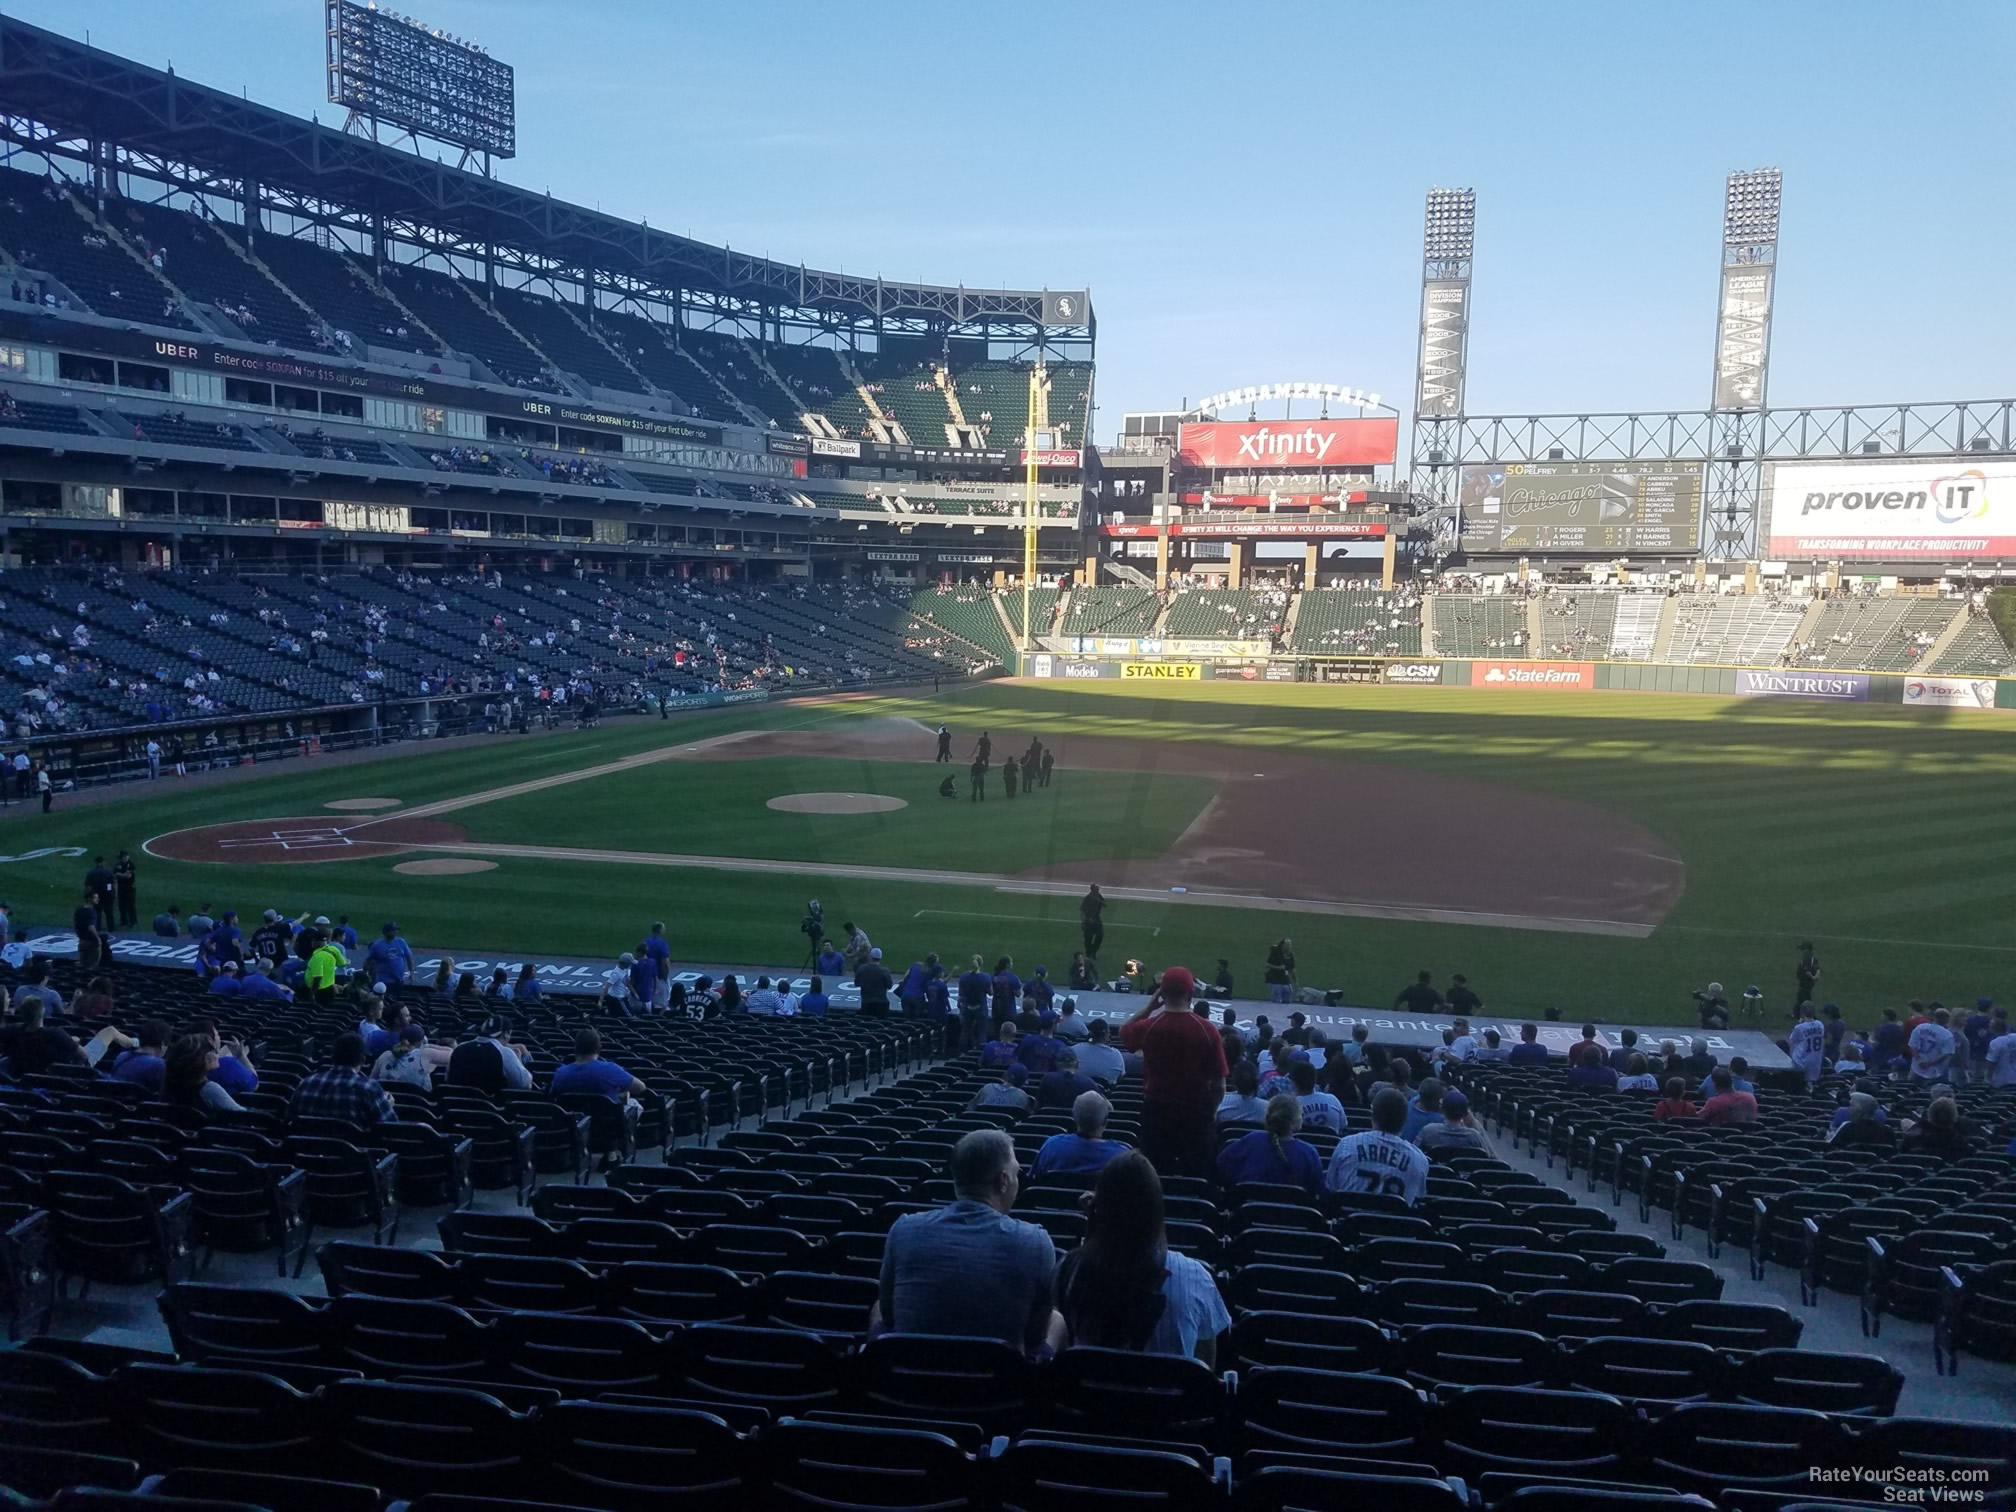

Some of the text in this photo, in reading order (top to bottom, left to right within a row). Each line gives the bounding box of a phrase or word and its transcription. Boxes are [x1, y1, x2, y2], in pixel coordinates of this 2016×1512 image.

[155, 342, 198, 360] UBER
[214, 352, 240, 366] Enter
[242, 358, 263, 369] cod
[266, 360, 302, 376] SOXFAN
[304, 367, 316, 378] for
[318, 370, 334, 381] $15
[336, 374, 348, 383] off
[350, 376, 368, 386] your
[408, 383, 424, 395] ride
[1198, 382, 1382, 416] FUNDAMENTALS
[522, 402, 551, 415] UBER
[561, 408, 707, 439] Enter code SOXFAN for $15 off your first Uber ride
[772, 442, 806, 452] whitesox.com
[828, 444, 856, 454] Ballpark
[1238, 426, 1337, 461] xfinity
[1022, 454, 1076, 465] ewel-Osco
[1506, 465, 1524, 475] 50
[1506, 482, 1601, 518] Chicago
[1801, 486, 1975, 516] proven IT
[1118, 526, 1139, 535] xfinity
[1798, 539, 1990, 550] TRANSFORMING WORKPLACE PRODUCTIVITY
[1066, 665, 1098, 678] Modelo
[1126, 665, 1195, 678] STANLEY
[1407, 665, 1440, 676] CSN
[1746, 672, 1858, 694] WINTRUST
[1930, 686, 1970, 696] TOTAL
[262, 940, 277, 955] 10
[686, 1004, 705, 1020] 53
[1806, 1036, 1821, 1052] 18
[1302, 1103, 1328, 1116] ORIANO
[1356, 1144, 1411, 1172] ABREU
